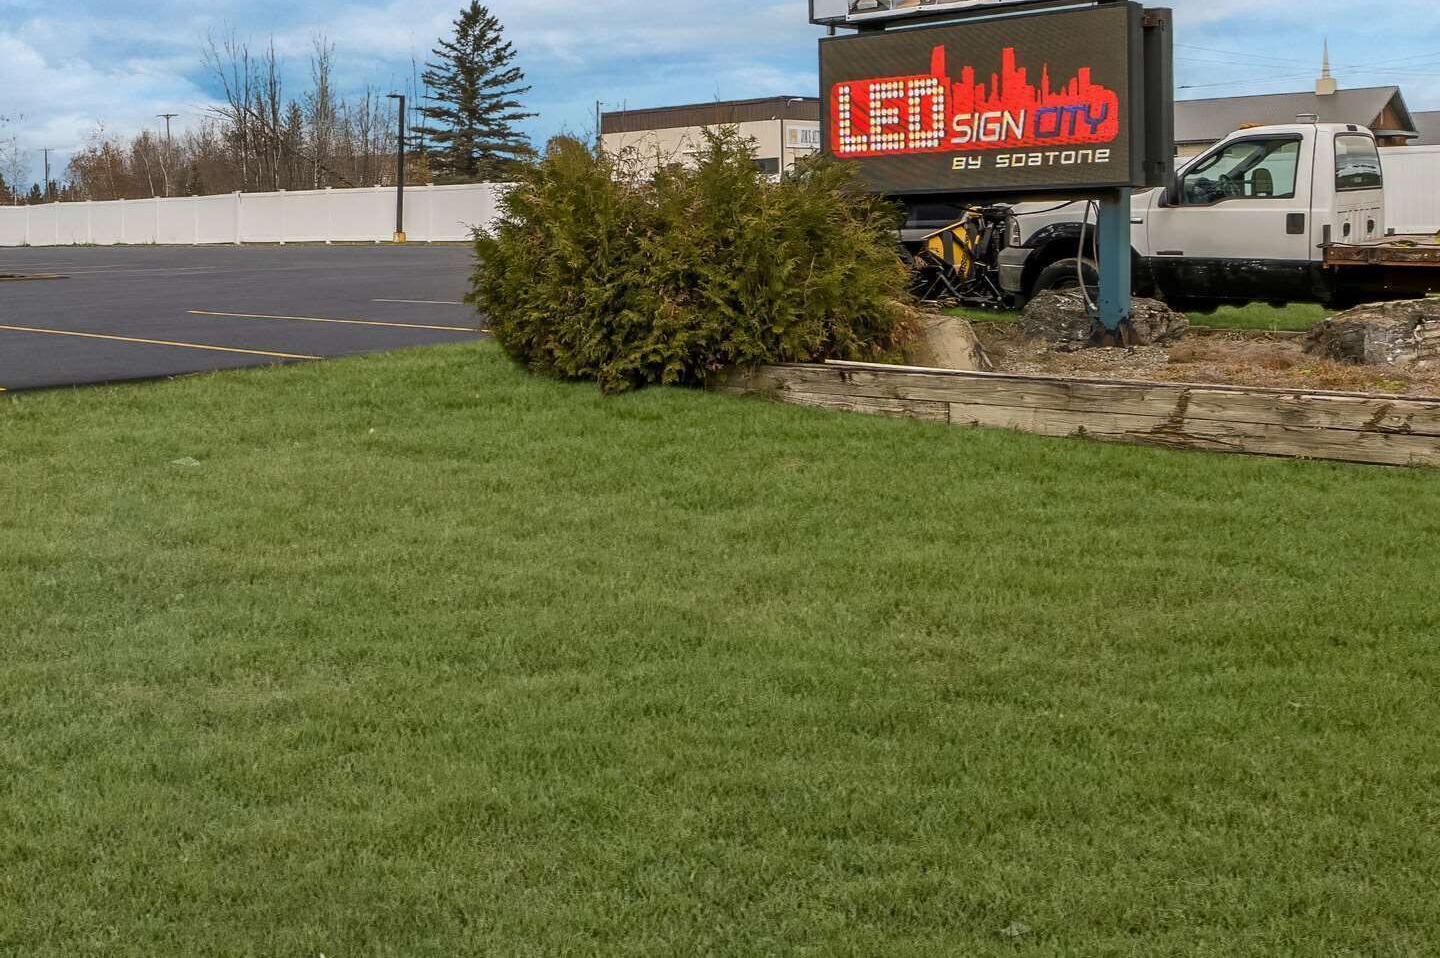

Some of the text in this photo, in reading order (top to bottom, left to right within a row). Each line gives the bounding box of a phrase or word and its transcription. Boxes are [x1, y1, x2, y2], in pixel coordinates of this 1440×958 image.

[839, 78, 945, 152] LED
[950, 108, 1025, 144] SIGN
[1034, 102, 1108, 139] CITY
[951, 155, 982, 170] BY
